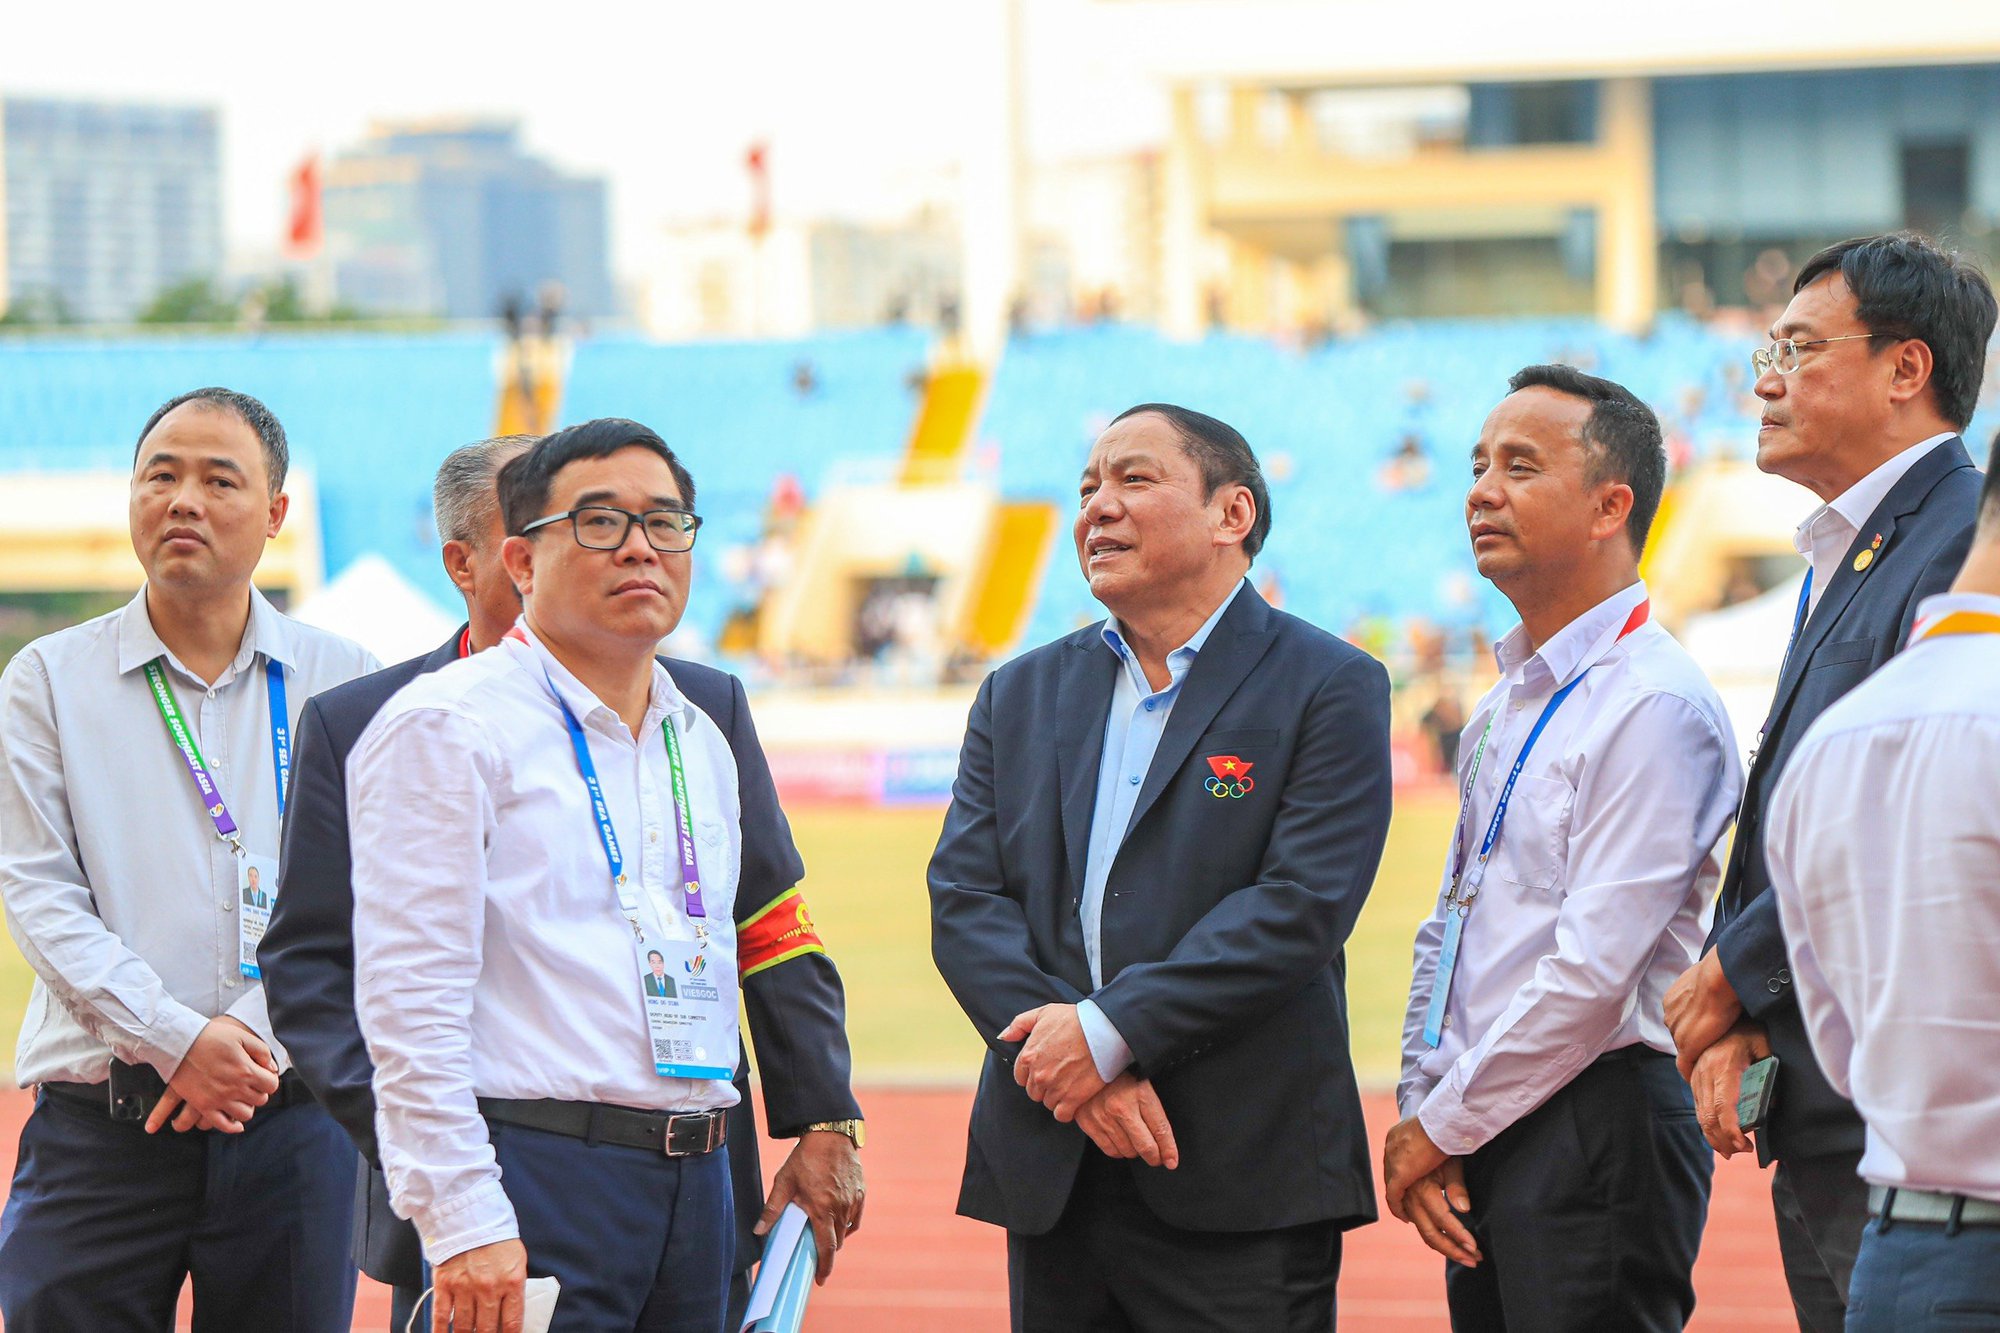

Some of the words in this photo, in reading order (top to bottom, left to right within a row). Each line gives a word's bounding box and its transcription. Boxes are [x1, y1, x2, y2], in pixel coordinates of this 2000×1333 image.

[148, 664, 175, 716] STRONGER
[170, 718, 203, 771] SOUTHEAST
[195, 771, 213, 795] ASIA
[665, 715, 681, 768] RONGER
[278, 747, 289, 767] SEA
[673, 768, 691, 838] SOUTHEAST
[1501, 784, 1512, 804] SEA
[595, 799, 608, 821] SEA
[602, 823, 621, 864] GAMES
[1487, 805, 1503, 845] GAMES
[681, 837, 694, 866] ASIA
